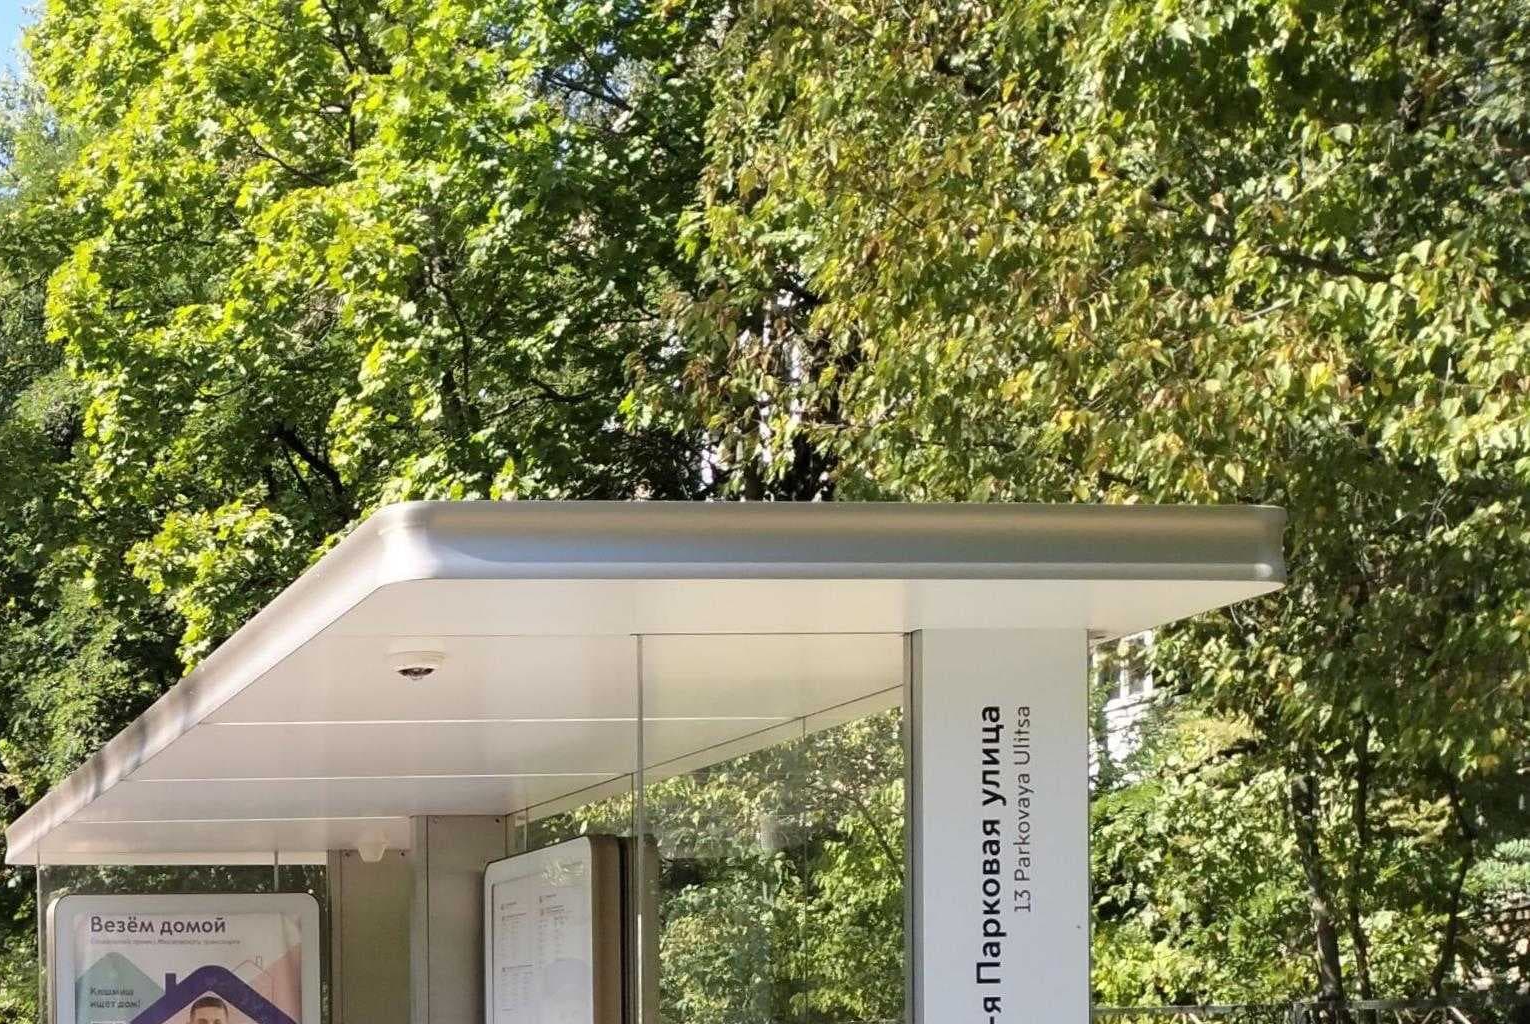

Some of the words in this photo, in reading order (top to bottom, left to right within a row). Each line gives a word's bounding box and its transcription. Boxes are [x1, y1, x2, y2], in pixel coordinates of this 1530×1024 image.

[981, 705, 1007, 806] улица
[1012, 706, 1031, 765] Ulitsa
[1012, 773, 1035, 881] Parkovaya
[90, 915, 155, 933] Везём
[160, 916, 227, 936] домой
[976, 819, 1007, 984] Парковая
[1013, 889, 1032, 913] 13
